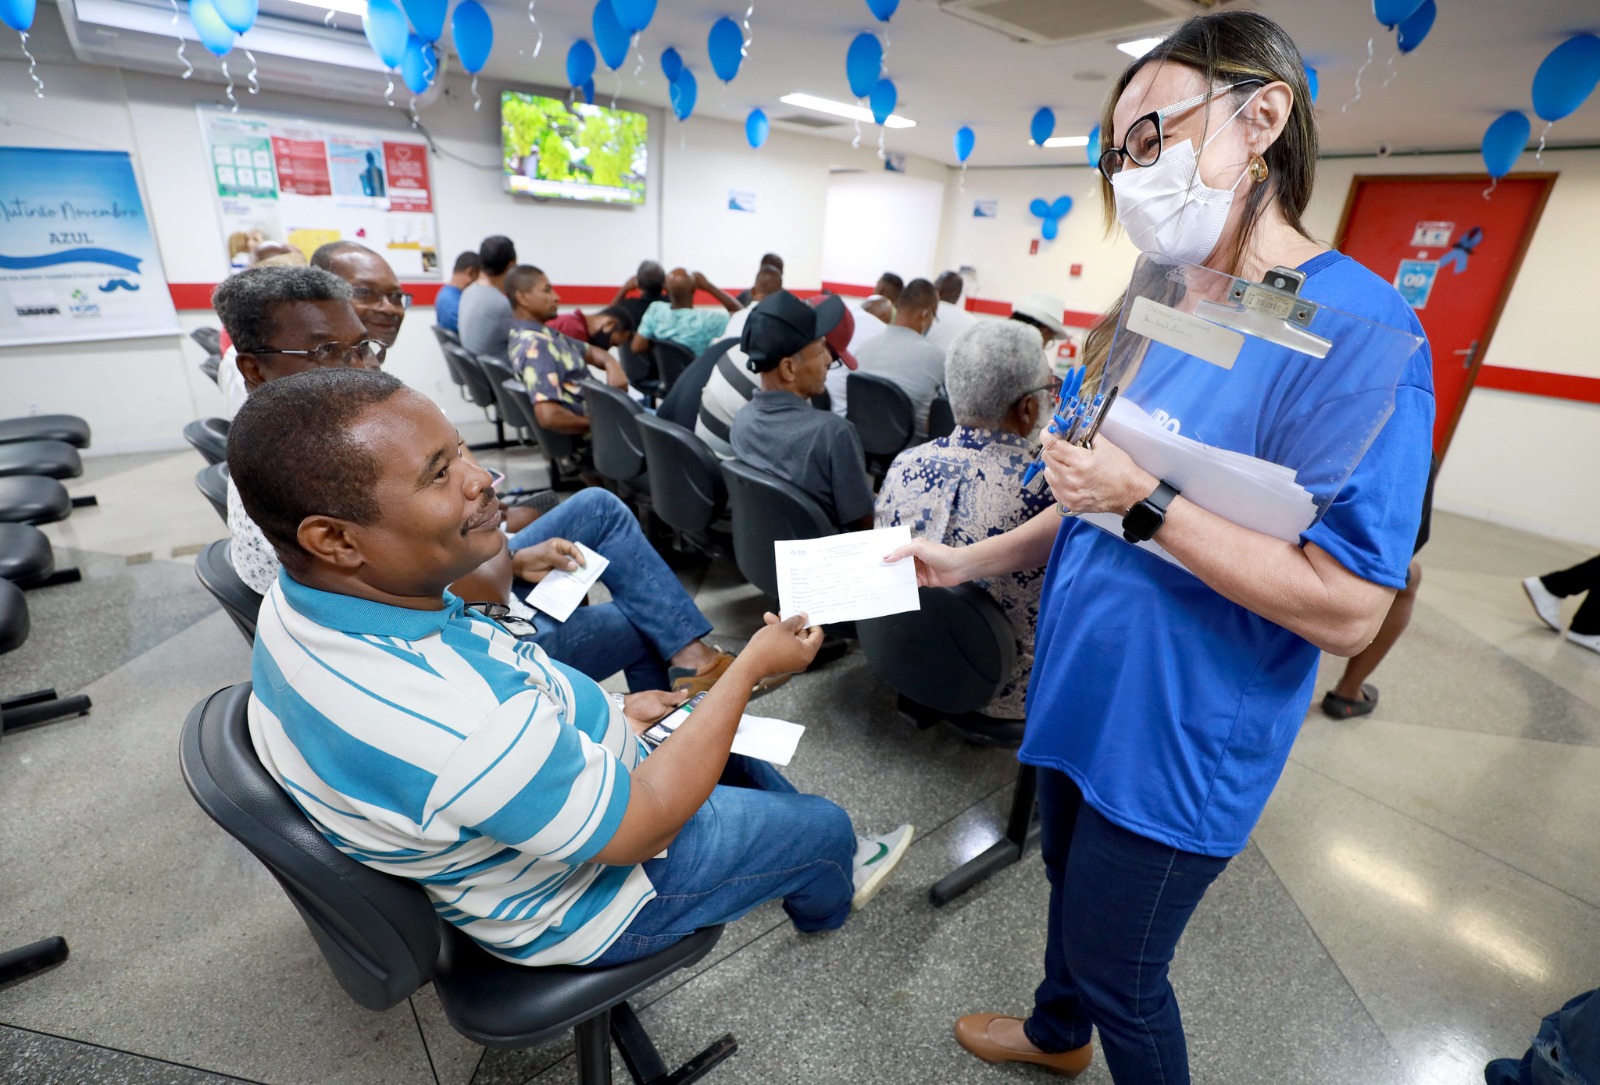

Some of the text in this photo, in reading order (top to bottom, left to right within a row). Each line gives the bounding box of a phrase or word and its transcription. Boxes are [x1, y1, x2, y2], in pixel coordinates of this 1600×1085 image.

[61, 201, 138, 222] Novembro
[50, 232, 94, 244] AZUL
[1403, 273, 1426, 287] 09
